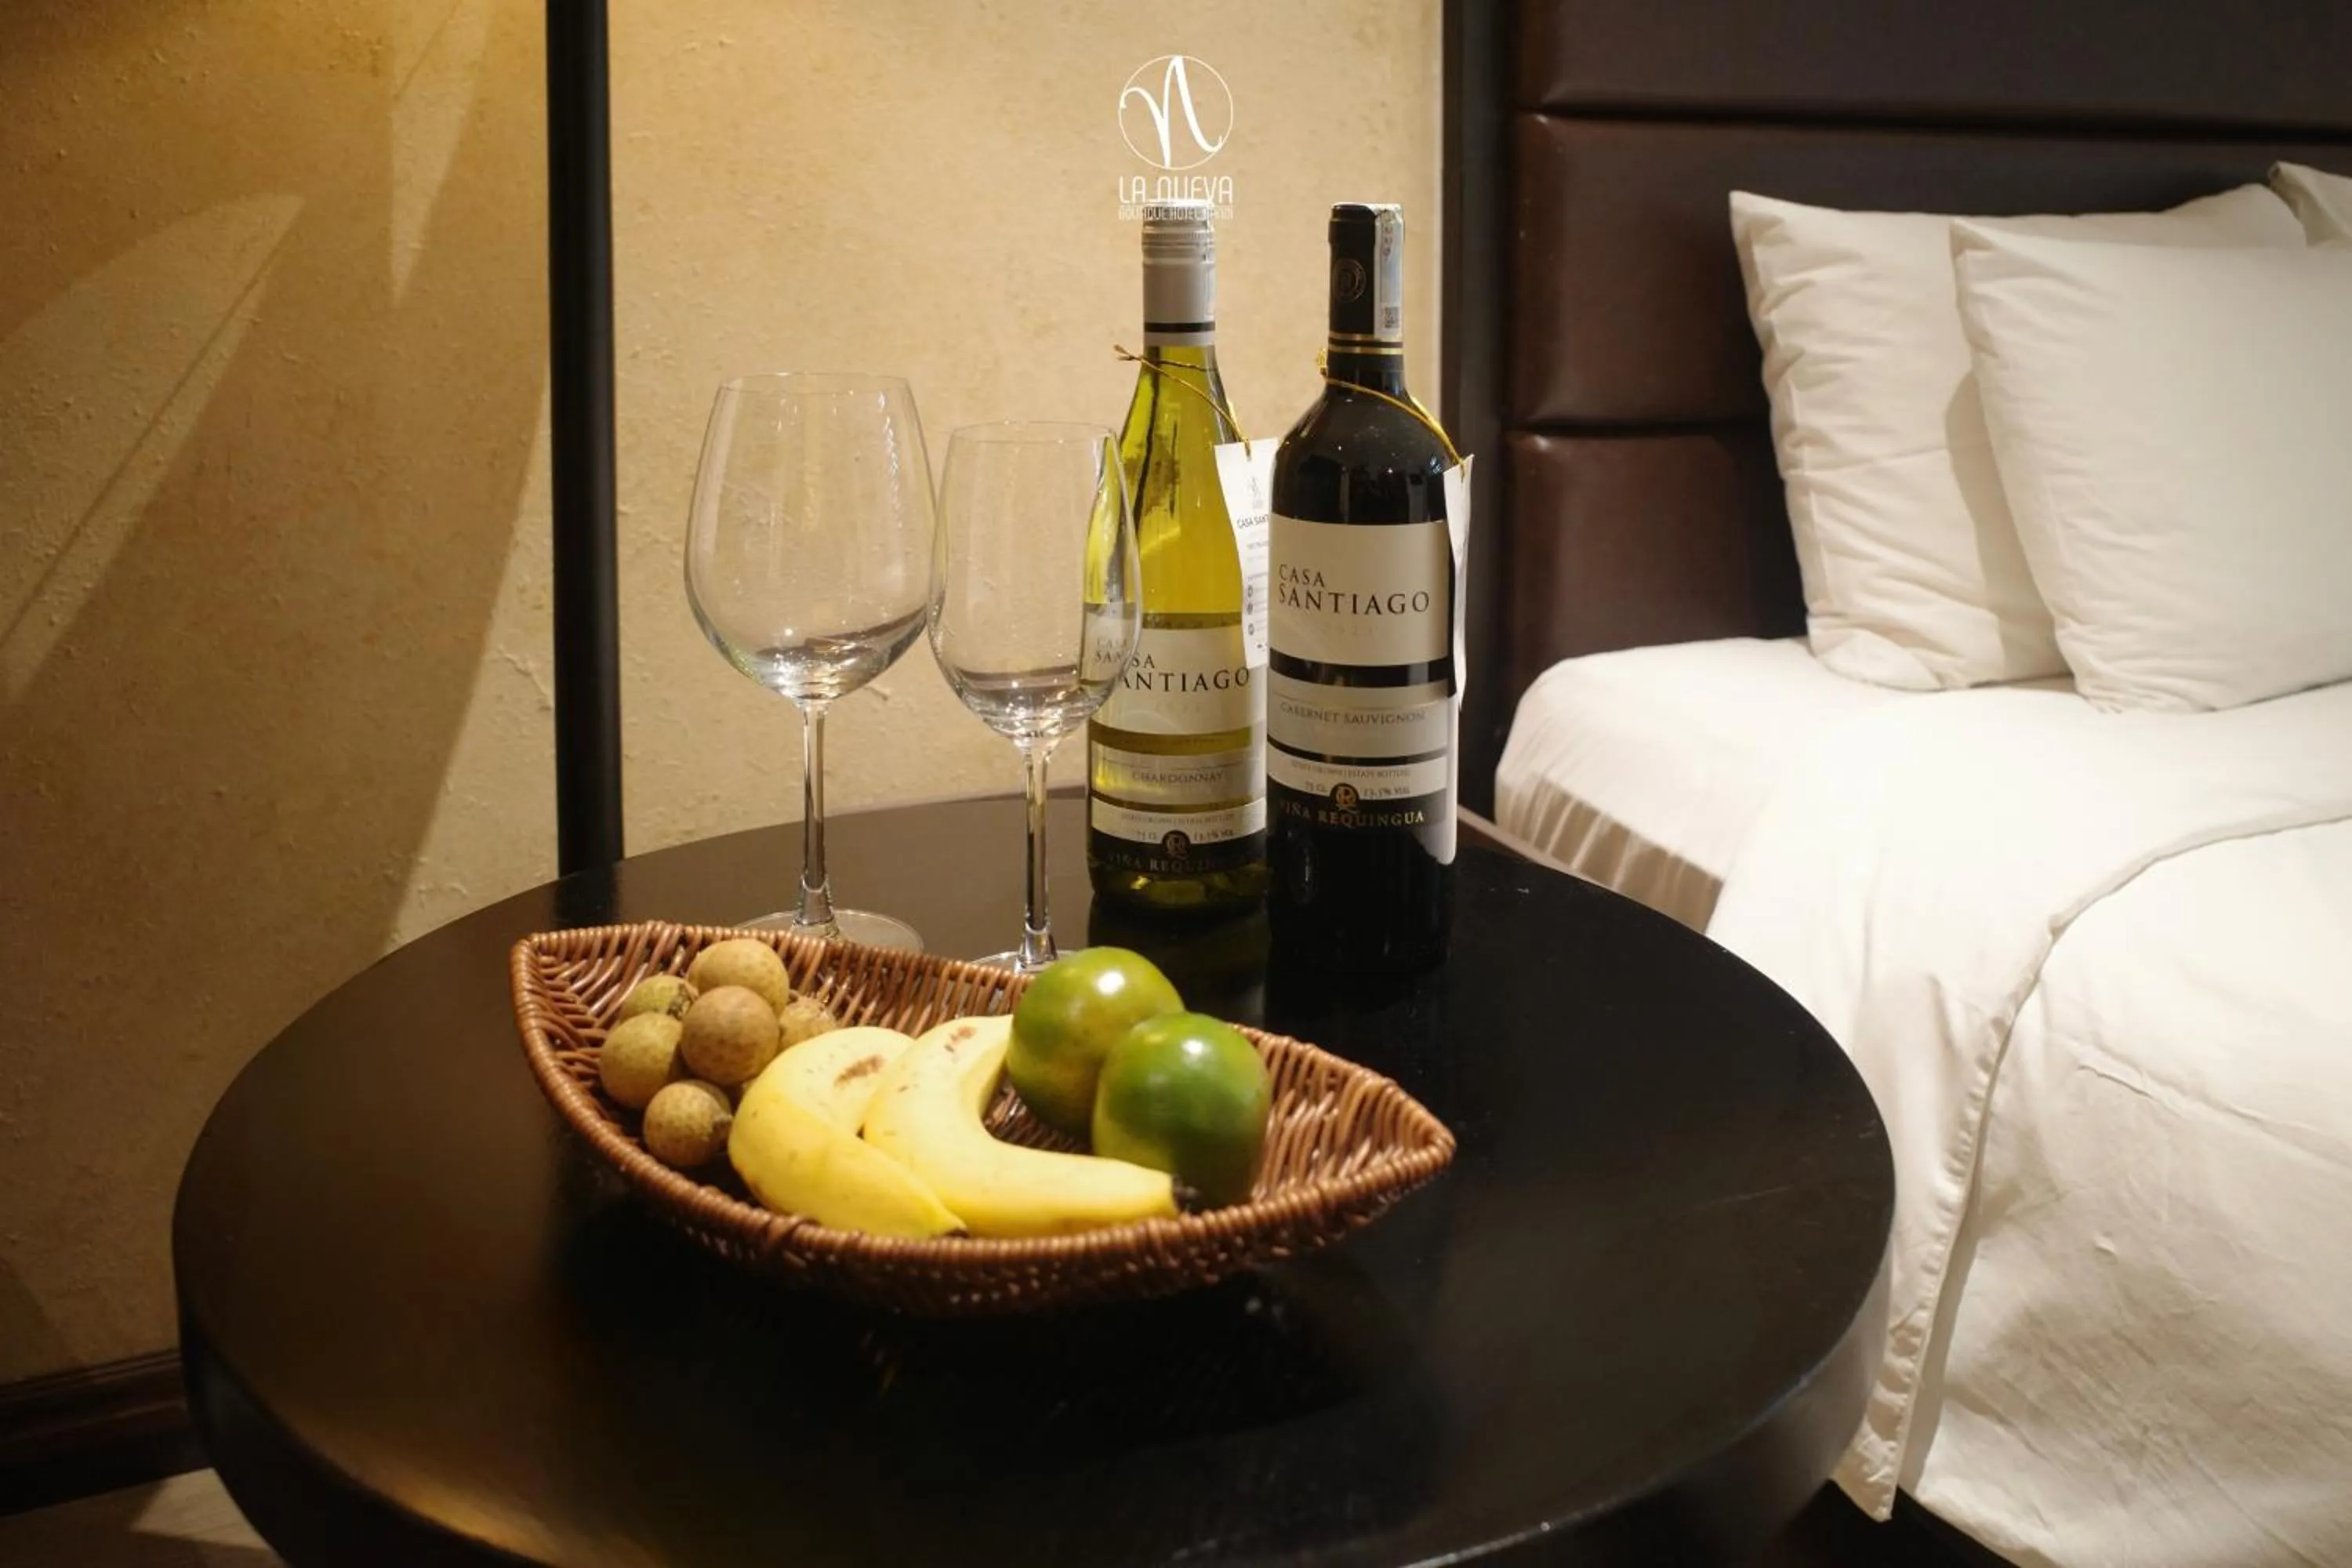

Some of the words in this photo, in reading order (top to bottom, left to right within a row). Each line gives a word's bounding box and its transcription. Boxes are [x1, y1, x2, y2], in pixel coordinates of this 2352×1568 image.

[1279, 564, 1325, 588] CASA
[1279, 583, 1430, 615] SANTIAGO
[1121, 667, 1250, 692] ANTIAGO
[1280, 702, 1339, 724] CABERNET
[1344, 708, 1426, 726] SAUVIGNON
[1132, 769, 1224, 783] CHARDONNAY
[1317, 810, 1425, 828] REQUINGUA
